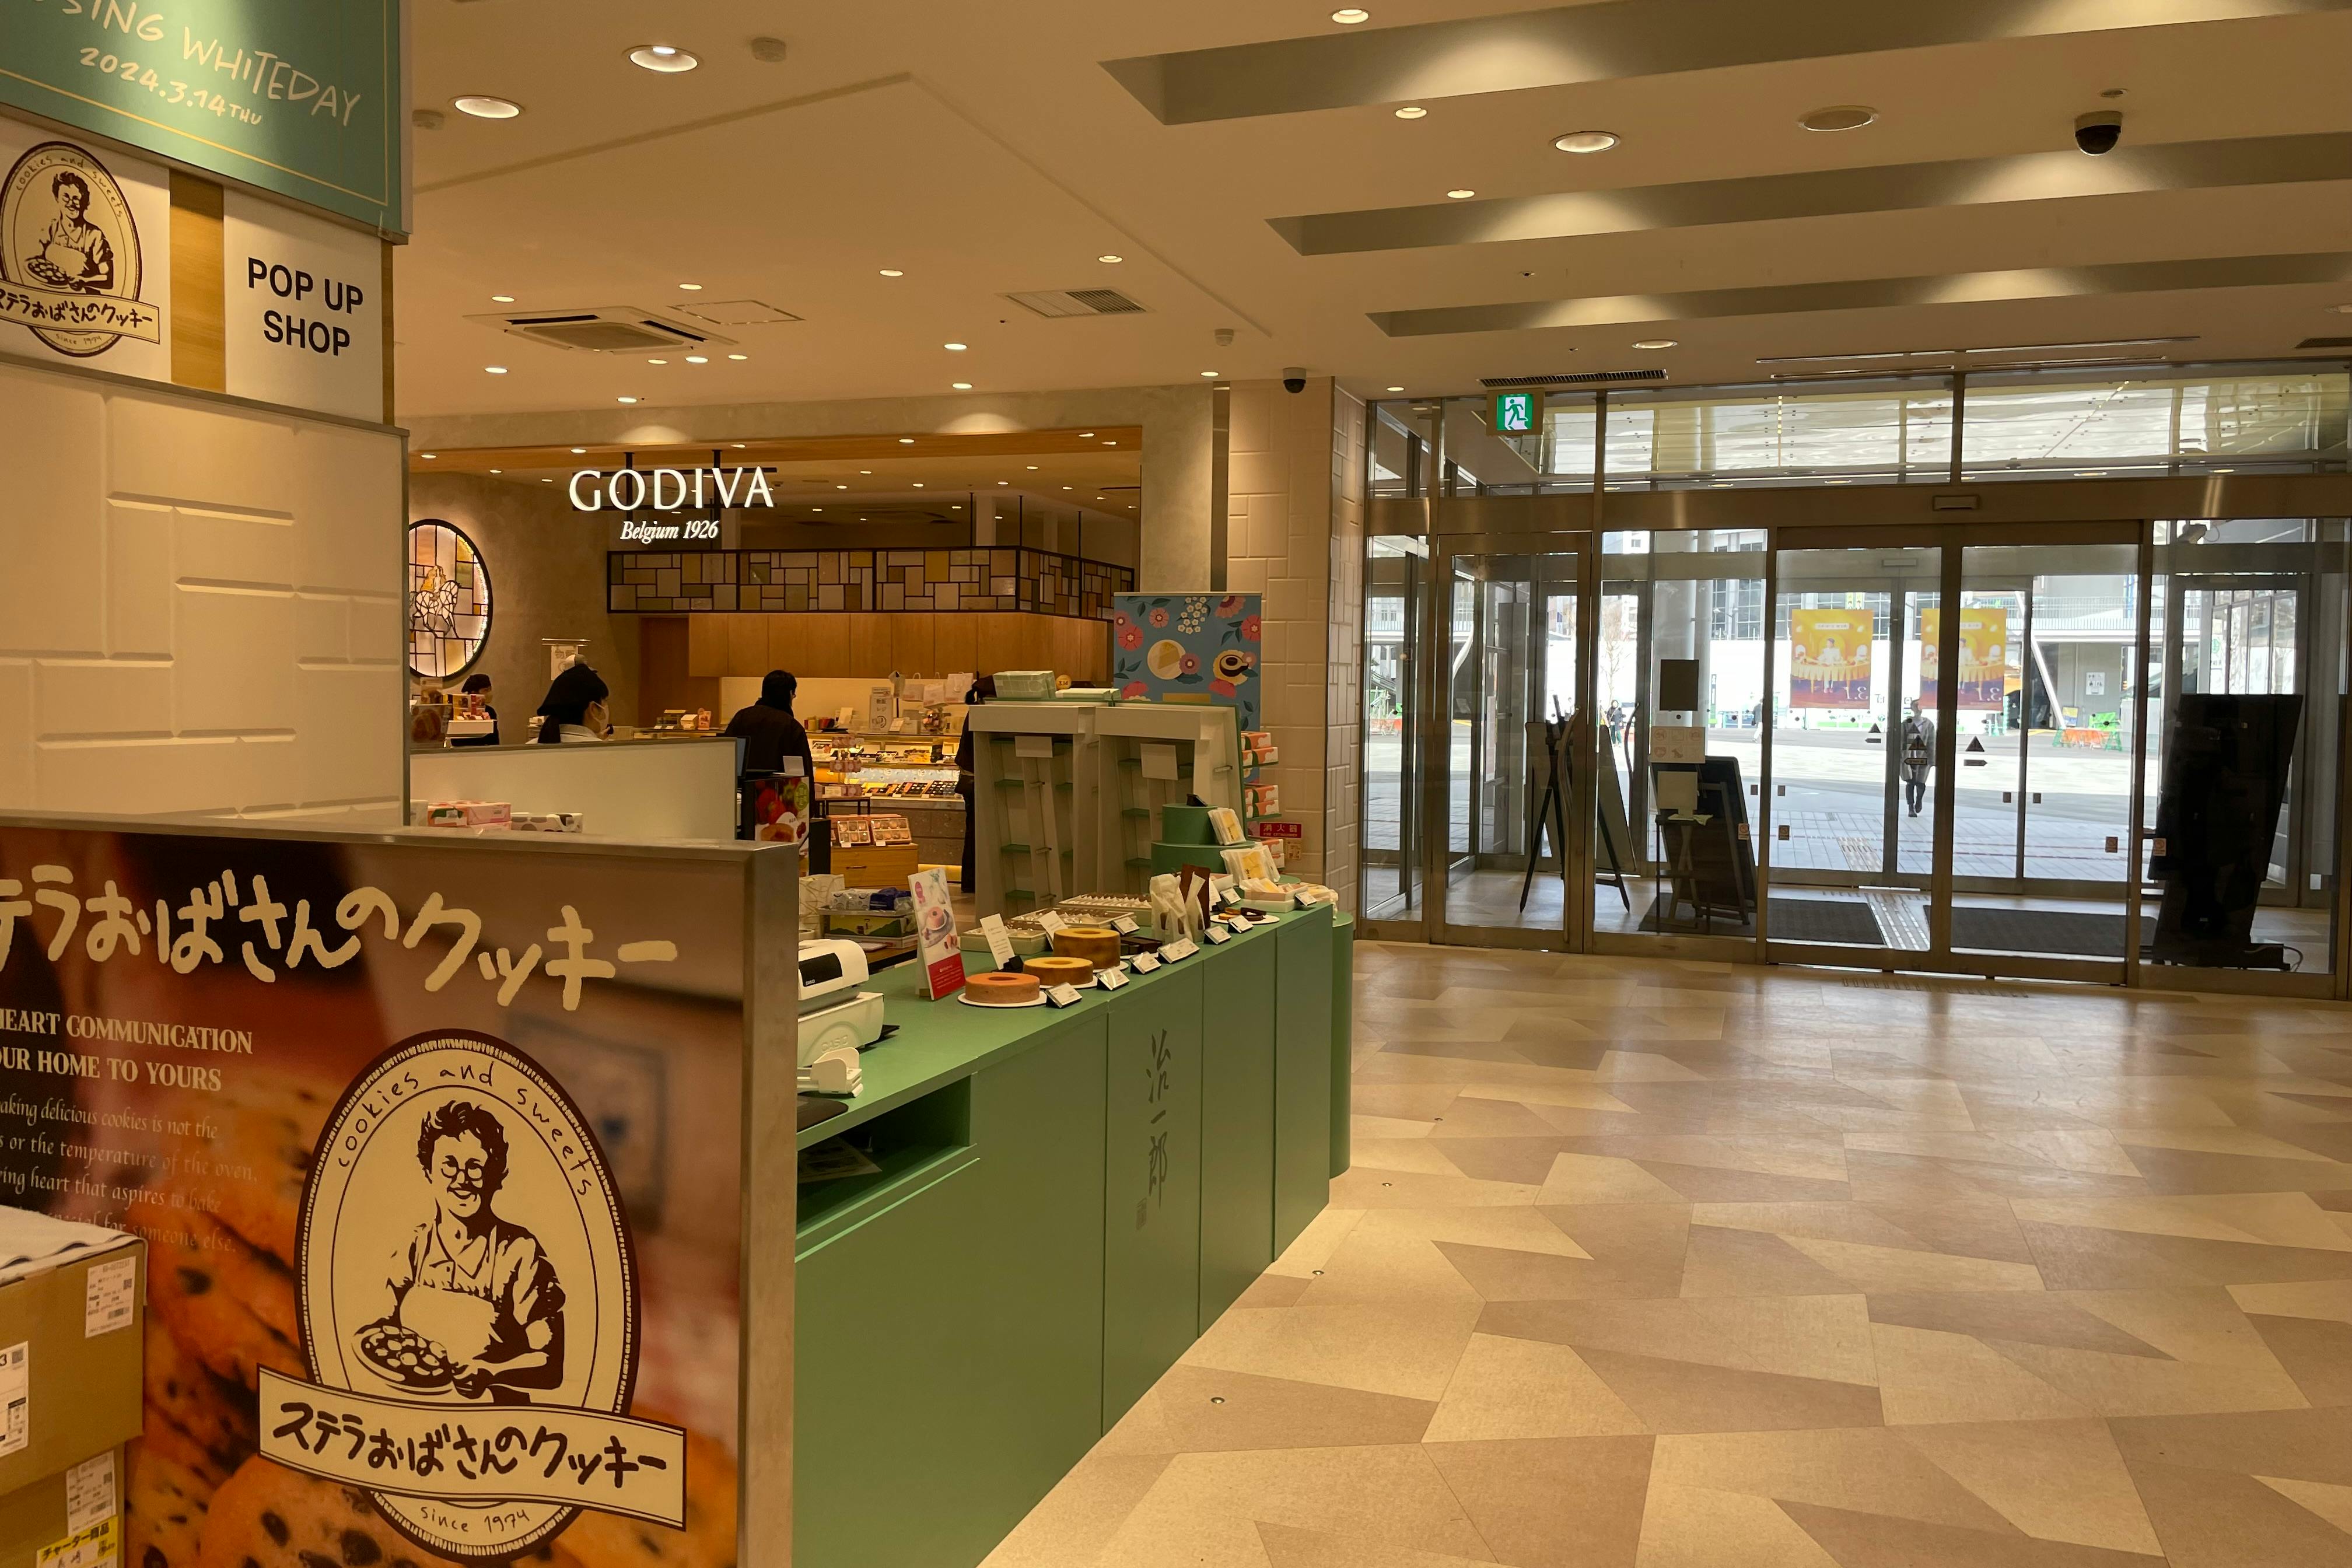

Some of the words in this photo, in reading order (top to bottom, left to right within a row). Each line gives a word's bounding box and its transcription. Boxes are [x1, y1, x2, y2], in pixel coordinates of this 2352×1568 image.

[182, 27, 361, 127] WHITEDAY
[61, 156, 85, 169] and
[92, 171, 124, 219] sweets
[248, 257, 314, 302] POP
[324, 278, 364, 314] UP
[263, 310, 351, 356] SHOP
[569, 465, 775, 512] GODIVA
[620, 520, 680, 544] Belgium
[682, 520, 719, 540] 1926
[66, 1014, 253, 1055] COMMUNICATION
[0, 1046, 32, 1072] UR
[37, 1052, 100, 1079] HOME
[106, 1058, 139, 1083] TO
[145, 1061, 222, 1091] YOURS
[0, 1093, 37, 1126] aking
[40, 1097, 97, 1126] delicious
[101, 1107, 147, 1131] cookies
[152, 1115, 163, 1133] is
[167, 1120, 191, 1136] not
[196, 1116, 218, 1139] the
[338, 1072, 419, 1167] cookies
[439, 1060, 495, 1087] and
[517, 1088, 592, 1196] sweets
[9, 1136, 26, 1150] or
[31, 1131, 54, 1155] the
[60, 1142, 157, 1168] temperature
[162, 1149, 180, 1175] of
[184, 1150, 208, 1175] the
[0, 1167, 26, 1195] ing
[31, 1165, 70, 1192] heart
[75, 1172, 107, 1198] that
[112, 1184, 164, 1212] aspires
[171, 1191, 184, 1208] to
[189, 1187, 222, 1213] bake
[272, 1402, 667, 1488] ステラおばさんのクッキー
[421, 1506, 469, 1532] since
[484, 1508, 530, 1534] 1974
